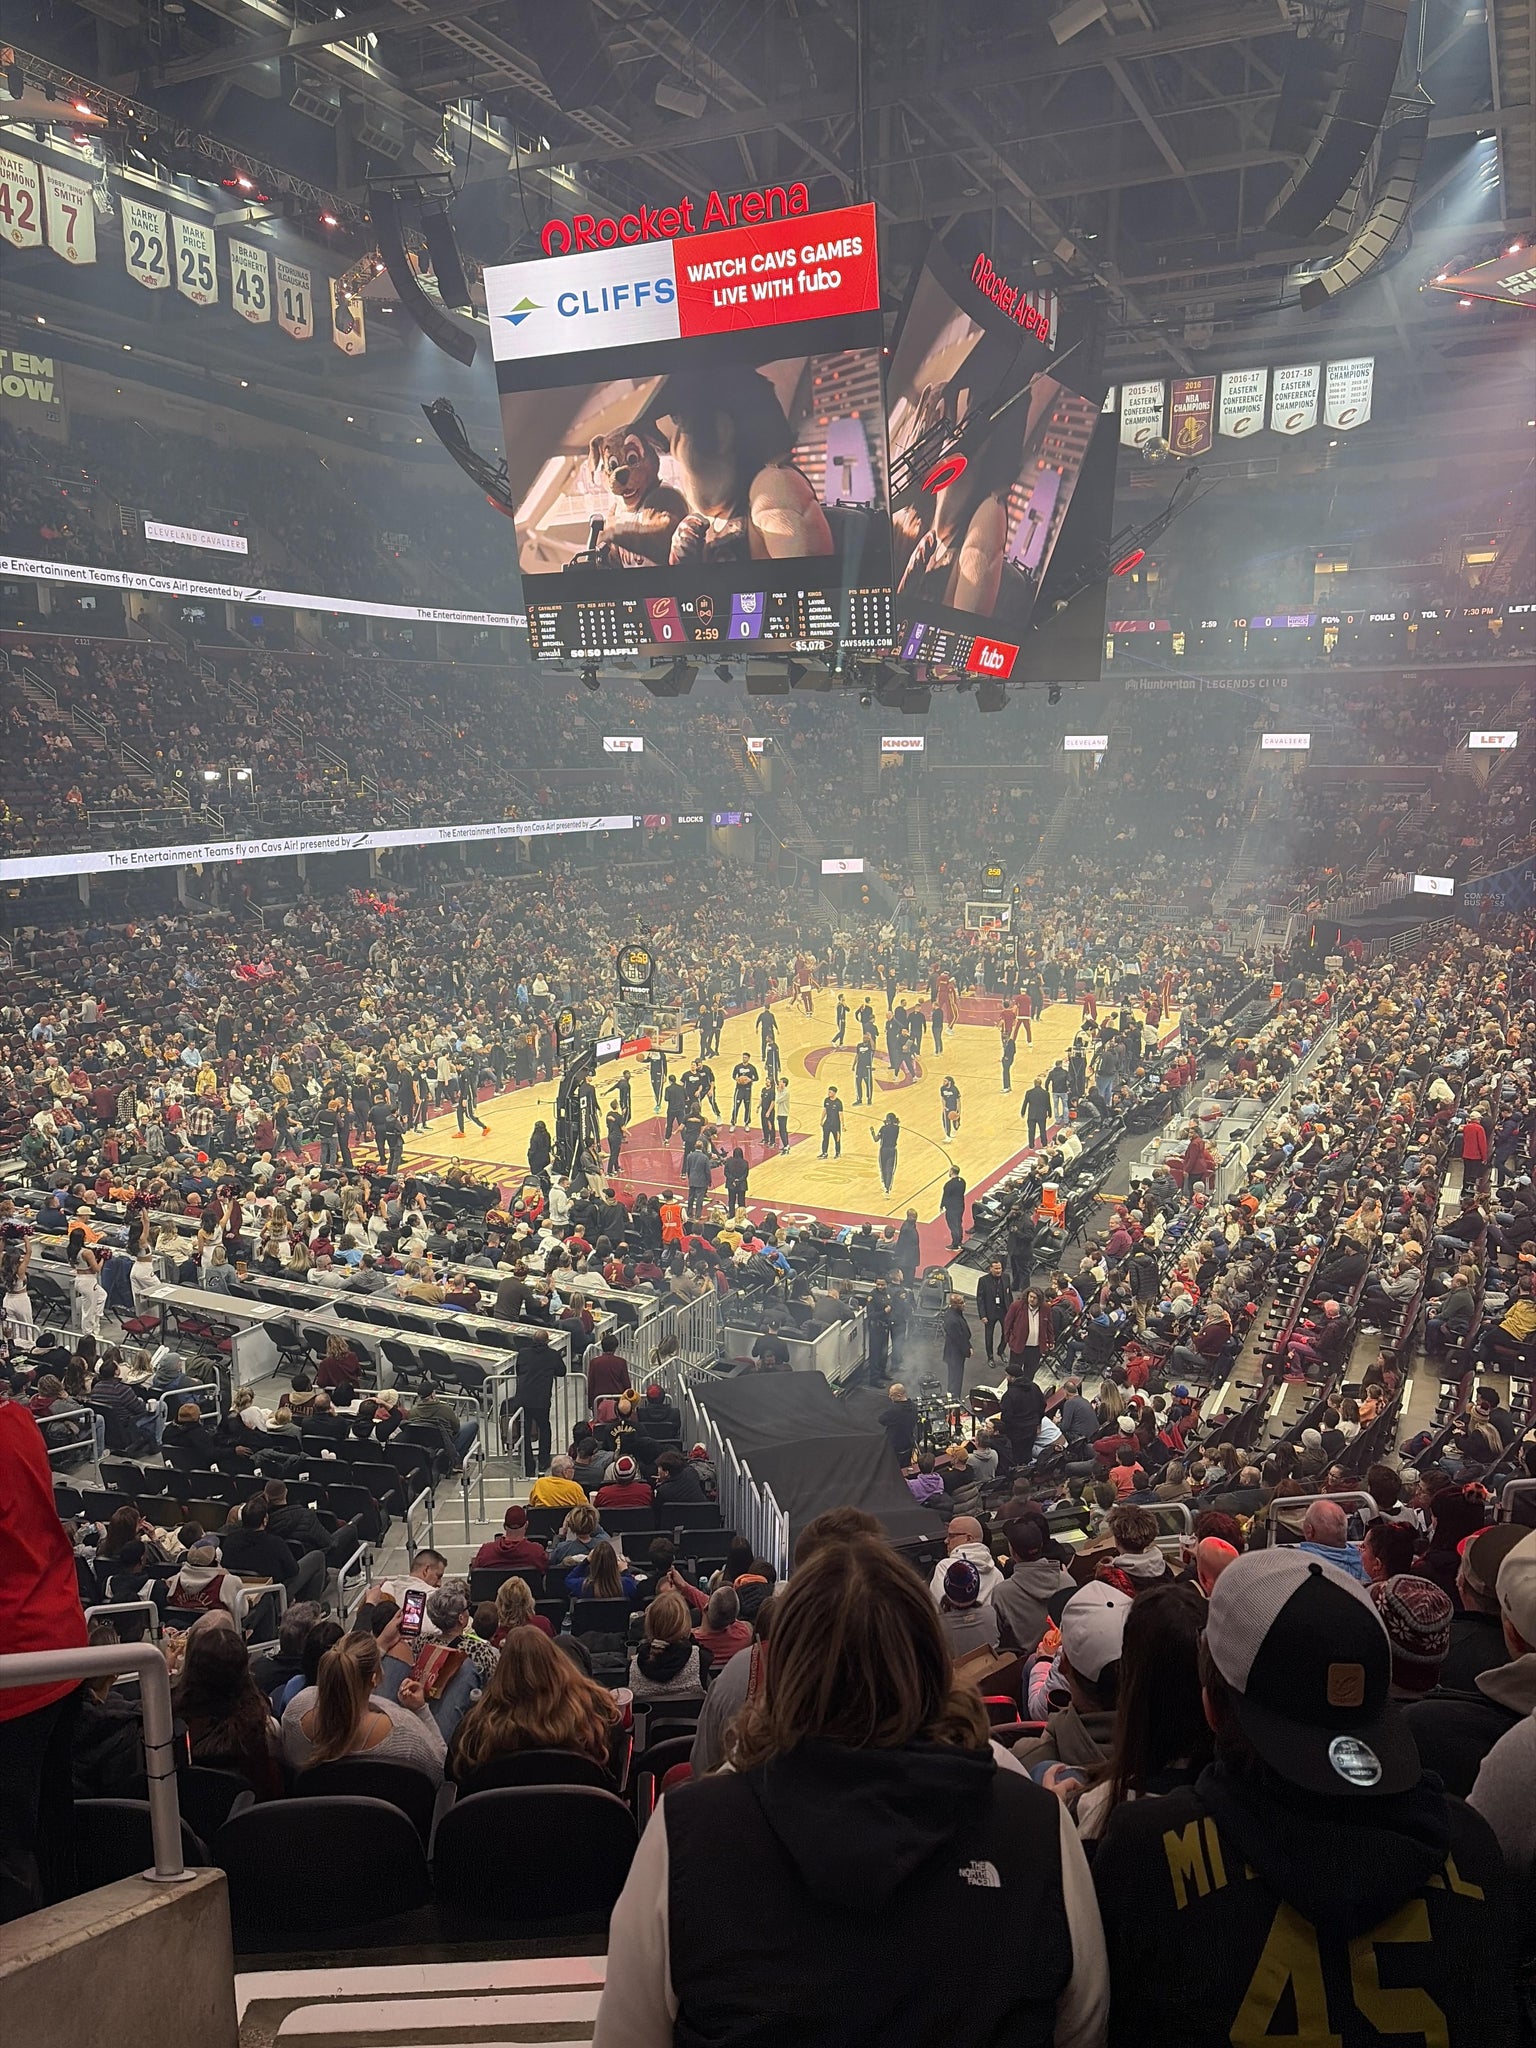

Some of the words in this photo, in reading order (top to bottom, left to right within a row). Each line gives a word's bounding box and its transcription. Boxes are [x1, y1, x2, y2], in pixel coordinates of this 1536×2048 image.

[0, 157, 24, 173] NATE
[54, 187, 83, 206] SMITH
[0, 182, 36, 232] 42
[131, 205, 158, 223] LARRY
[574, 195, 696, 251] Rocket
[701, 182, 810, 231] Arena
[61, 203, 78, 244] 7
[131, 217, 160, 234] NANCE
[182, 224, 206, 240] MARK
[183, 235, 207, 251] PRICE
[129, 230, 165, 275] 22
[238, 246, 258, 260] BRAD
[687, 256, 747, 284] WATCH
[750, 248, 798, 273] CAVS
[800, 235, 863, 264] GAMES
[180, 248, 214, 291] 25
[1496, 271, 1530, 289] LET
[236, 269, 266, 310] 43
[713, 285, 748, 308] LIVE
[751, 278, 794, 303] WITH
[797, 267, 842, 294] fubo
[557, 277, 676, 318] CLIFFS
[978, 258, 1019, 316] Rocket
[1012, 293, 1050, 343] Arena
[284, 288, 307, 326] 11
[12, 351, 54, 378] EM
[1327, 364, 1349, 373] CENTRAL
[1350, 362, 1373, 371] DIVISION
[1228, 373, 1260, 384] 2016-17
[1280, 368, 1313, 380] 2017-18
[1329, 368, 1370, 381] CHAMPIONS
[1128, 385, 1158, 396] 2015-16
[1185, 381, 1202, 390] 2016
[1229, 385, 1258, 395] EASTERN
[1281, 380, 1311, 391] EASTERN
[1185, 394, 1200, 403] NBA
[1223, 394, 1263, 406] CONFERENCE
[1274, 389, 1316, 401] CONFERENCE
[1129, 397, 1157, 406] EASTERN
[1173, 401, 1210, 413] CHAMPIONS
[1275, 399, 1314, 411] CHAMPIONS
[1124, 406, 1157, 416] CONFEREN
[1224, 404, 1261, 415] CHAMPIONS
[1125, 415, 1160, 425] CHAMPIONS
[147, 526, 198, 542] CLEVELAND
[200, 535, 246, 550] CAVALIERS
[11, 559, 87, 581] Entertainment
[89, 568, 121, 583] Teams
[122, 573, 133, 587] fly
[135, 578, 147, 587] on
[148, 577, 171, 590] Cavs
[173, 580, 188, 592] Air!
[189, 584, 232, 598] presented
[232, 587, 243, 600] by
[681, 602, 694, 612] 1Q
[417, 609, 431, 618] The
[433, 610, 485, 622] Entertainment
[486, 614, 509, 624] Teams
[510, 616, 520, 625] fly
[1149, 621, 1155, 630] 0
[1201, 620, 1218, 628] 2:59
[1233, 619, 1247, 628] 1Q
[1265, 618, 1271, 627] 0
[1321, 616, 1340, 624] FG%
[1347, 616, 1353, 624] 0
[1369, 613, 1395, 622] FOULS
[1403, 612, 1409, 620] 0
[1421, 610, 1438, 619] TOL
[1444, 609, 1451, 618] 7
[1463, 608, 1479, 617] 7:30
[1481, 607, 1494, 616] PM
[1508, 604, 1529, 614] LET
[662, 624, 672, 640] 0
[694, 628, 719, 640] 2:59
[740, 621, 750, 637] 0
[795, 640, 826, 652] $5,078
[840, 639, 892, 648] CAVS5050.COM
[603, 648, 639, 656] RAFFLE
[979, 645, 1005, 669] fubo
[1206, 679, 1257, 689] LEGENDS
[613, 740, 634, 748] LET
[882, 739, 922, 748] KNOW.
[1066, 739, 1107, 747] CLEVELAND
[1480, 736, 1505, 744] LET
[660, 816, 666, 825] 0
[678, 815, 704, 824] BLOCKS
[715, 814, 721, 823] 0
[438, 829, 451, 839] The
[452, 826, 496, 838] Entertainment
[496, 825, 516, 834] Teams
[532, 823, 545, 832] Cavs
[556, 820, 582, 831] presented
[582, 820, 588, 829] by
[108, 853, 129, 866] The
[130, 849, 202, 864] Entertainment
[204, 845, 234, 858] Teams
[235, 843, 246, 857] fly
[248, 845, 259, 854] on
[261, 841, 282, 854] Cavs
[283, 839, 299, 851] Air!
[300, 836, 340, 852] presented
[341, 835, 351, 848] by
[1464, 892, 1506, 900] COMAST
[970, 1860, 986, 1870] THE
[1229, 1899, 1450, 2048] 45
